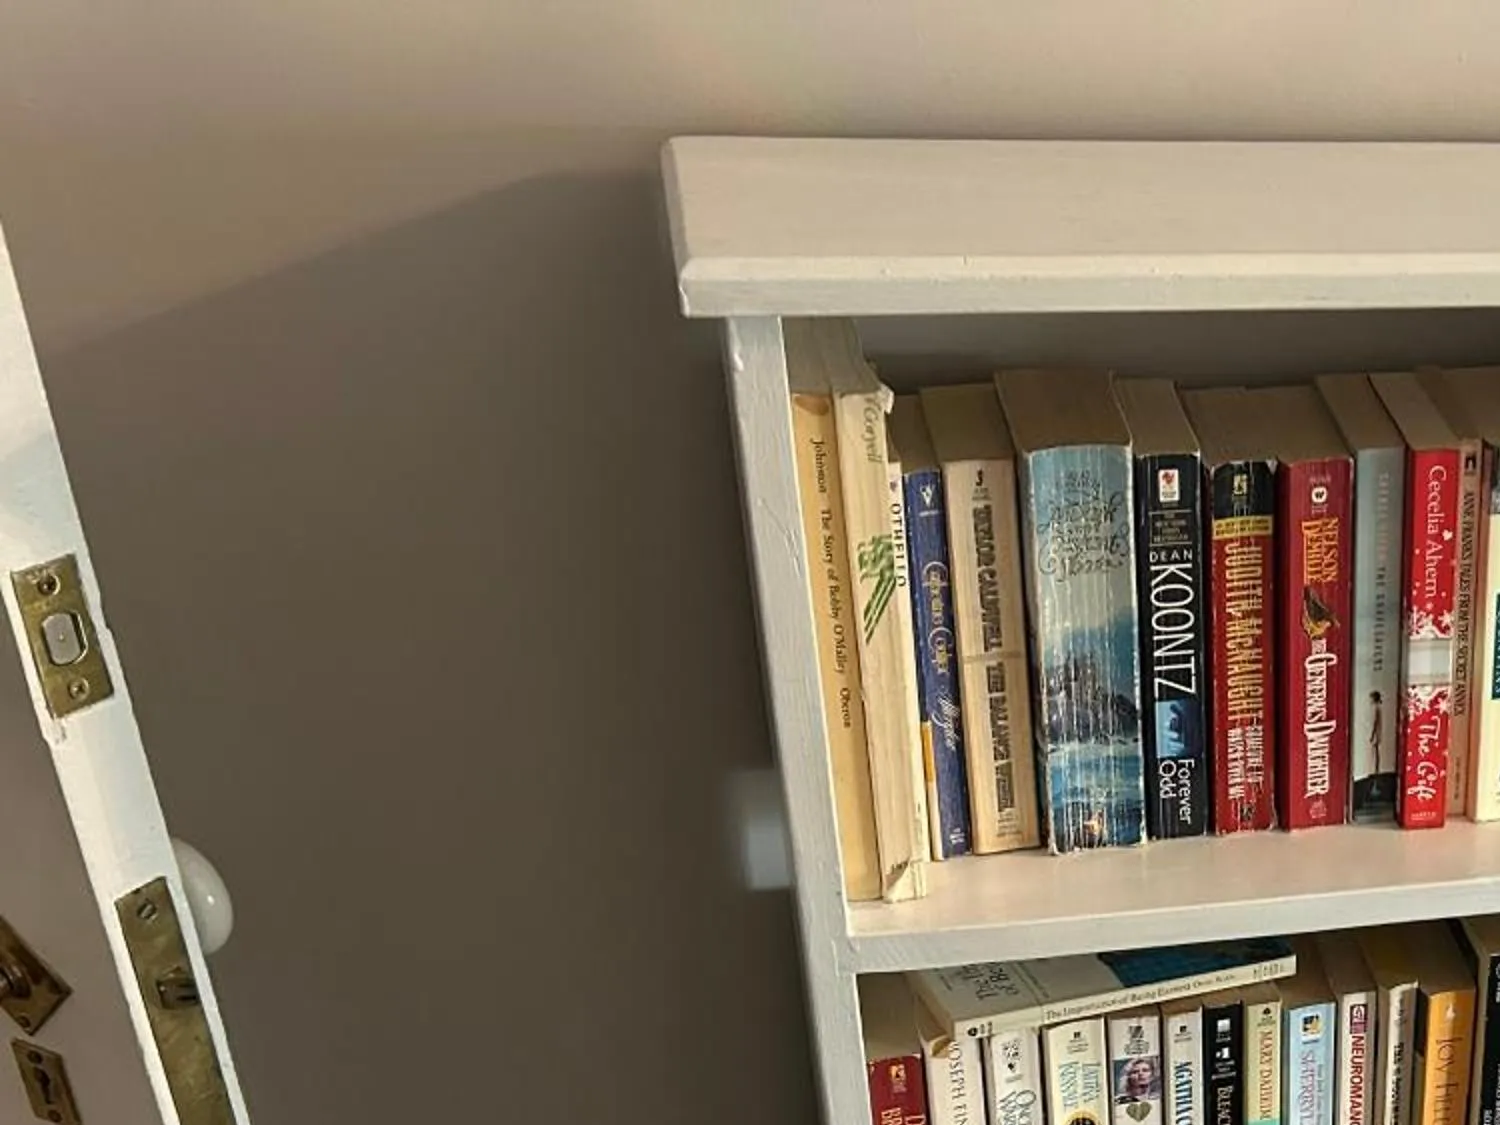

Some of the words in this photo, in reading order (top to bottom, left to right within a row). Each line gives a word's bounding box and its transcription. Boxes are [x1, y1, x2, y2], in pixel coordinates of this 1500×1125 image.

[811, 439, 830, 493] Johnson
[820, 509, 832, 531] The
[1427, 465, 1447, 535] Cecelia
[822, 535, 836, 564] Story
[1150, 550, 1193, 562] DEAN
[1319, 517, 1340, 583] NELSON
[1423, 540, 1442, 598] Ahern
[827, 569, 839, 580] of
[1224, 541, 1263, 610] JUDITH
[827, 586, 842, 619] Bobby
[1150, 563, 1197, 699] KOONTZ
[1303, 720, 1337, 799] DAUGHTER
[1417, 715, 1441, 757] The
[1159, 759, 1177, 799] Odd
[1176, 759, 1196, 824] Forever
[1407, 761, 1439, 802] Gift
[948, 1041, 967, 1099] JOSEPH
[1258, 1030, 1273, 1067] MARY
[1435, 1037, 1463, 1073] JOY
[1174, 1060, 1194, 1116] AGATHA
